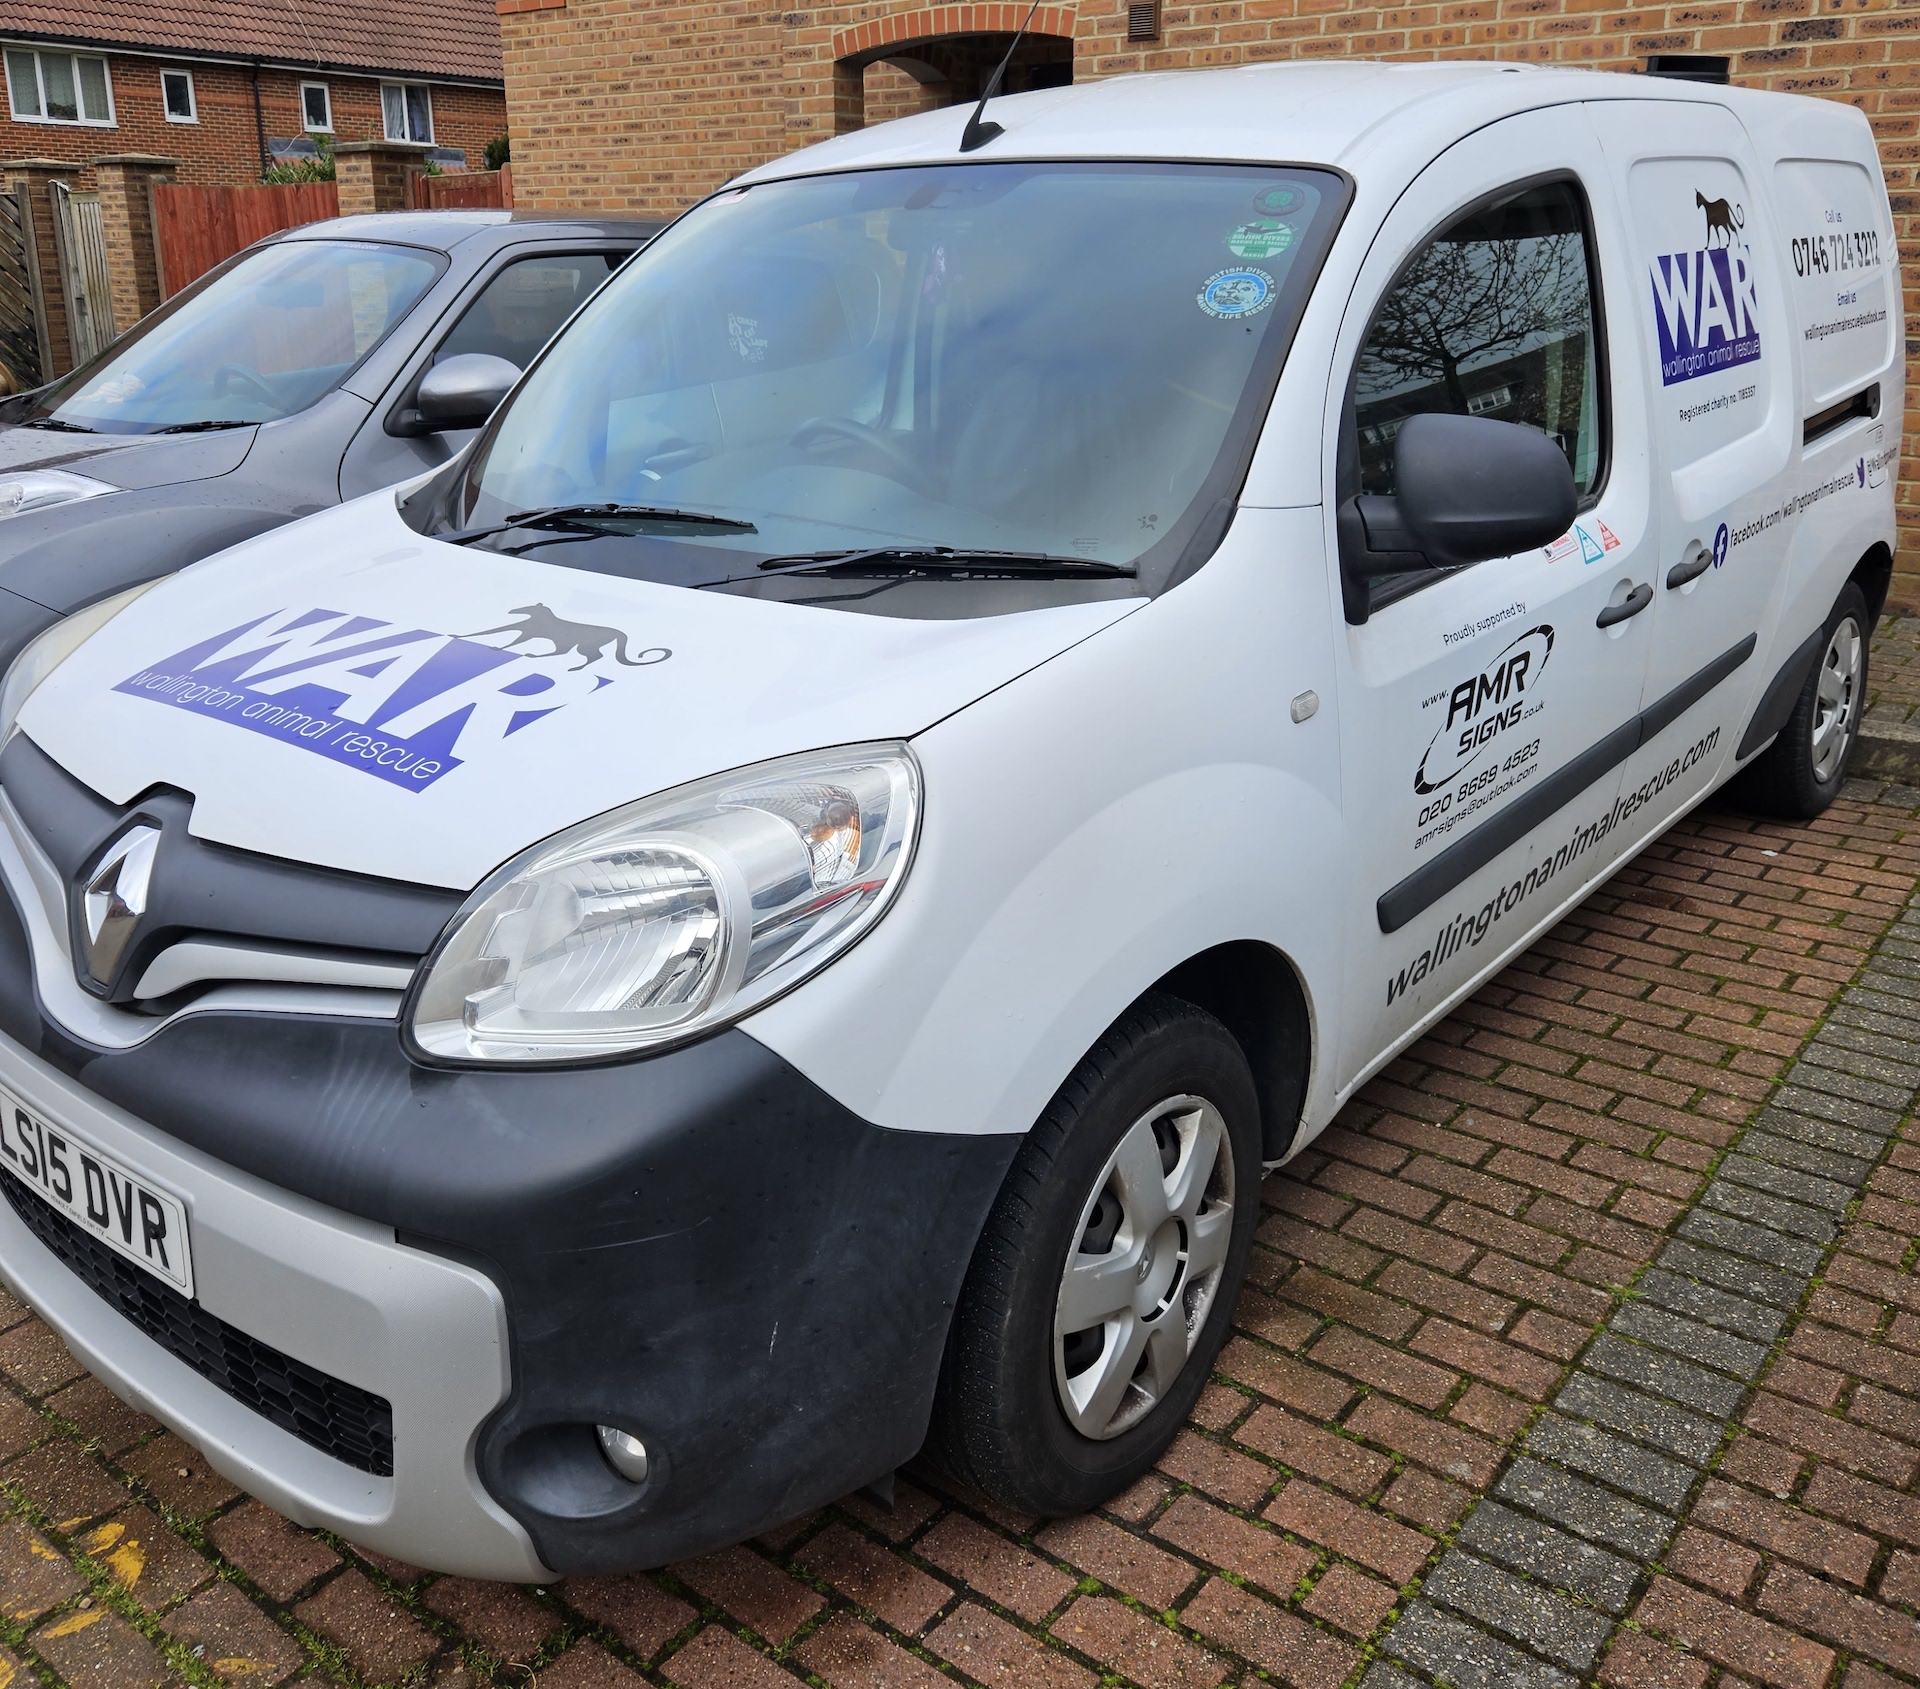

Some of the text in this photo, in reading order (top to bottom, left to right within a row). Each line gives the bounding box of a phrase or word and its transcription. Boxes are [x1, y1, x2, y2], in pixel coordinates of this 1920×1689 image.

[1792, 230, 1881, 277] 0746 724 3212
[1825, 210, 1842, 223] Call us
[1196, 292, 1276, 320] MARINE LIFE RESCUE
[1204, 266, 1275, 286] BRITISH DIVERS
[1650, 245, 1759, 351] WAR
[1837, 290, 1857, 306] Email us
[1663, 339, 1760, 378] wallington animal rescue
[1679, 400, 1710, 422] Registered
[1711, 394, 1729, 410] charity
[1729, 471, 1855, 548] facebook.com/wallingtonanimalrescue
[1443, 601, 1527, 646] Proudly supported by
[190, 607, 602, 757] WAR
[1421, 650, 1531, 733] www. AMR
[131, 671, 441, 780] wallington animal rescue
[1414, 763, 1538, 850] amrsigns@outlook.com
[1418, 738, 1541, 828] 020 8689 4523
[1387, 725, 1721, 1007] wallingtonanimalrescue.com
[79, 1152, 171, 1271] DVR
